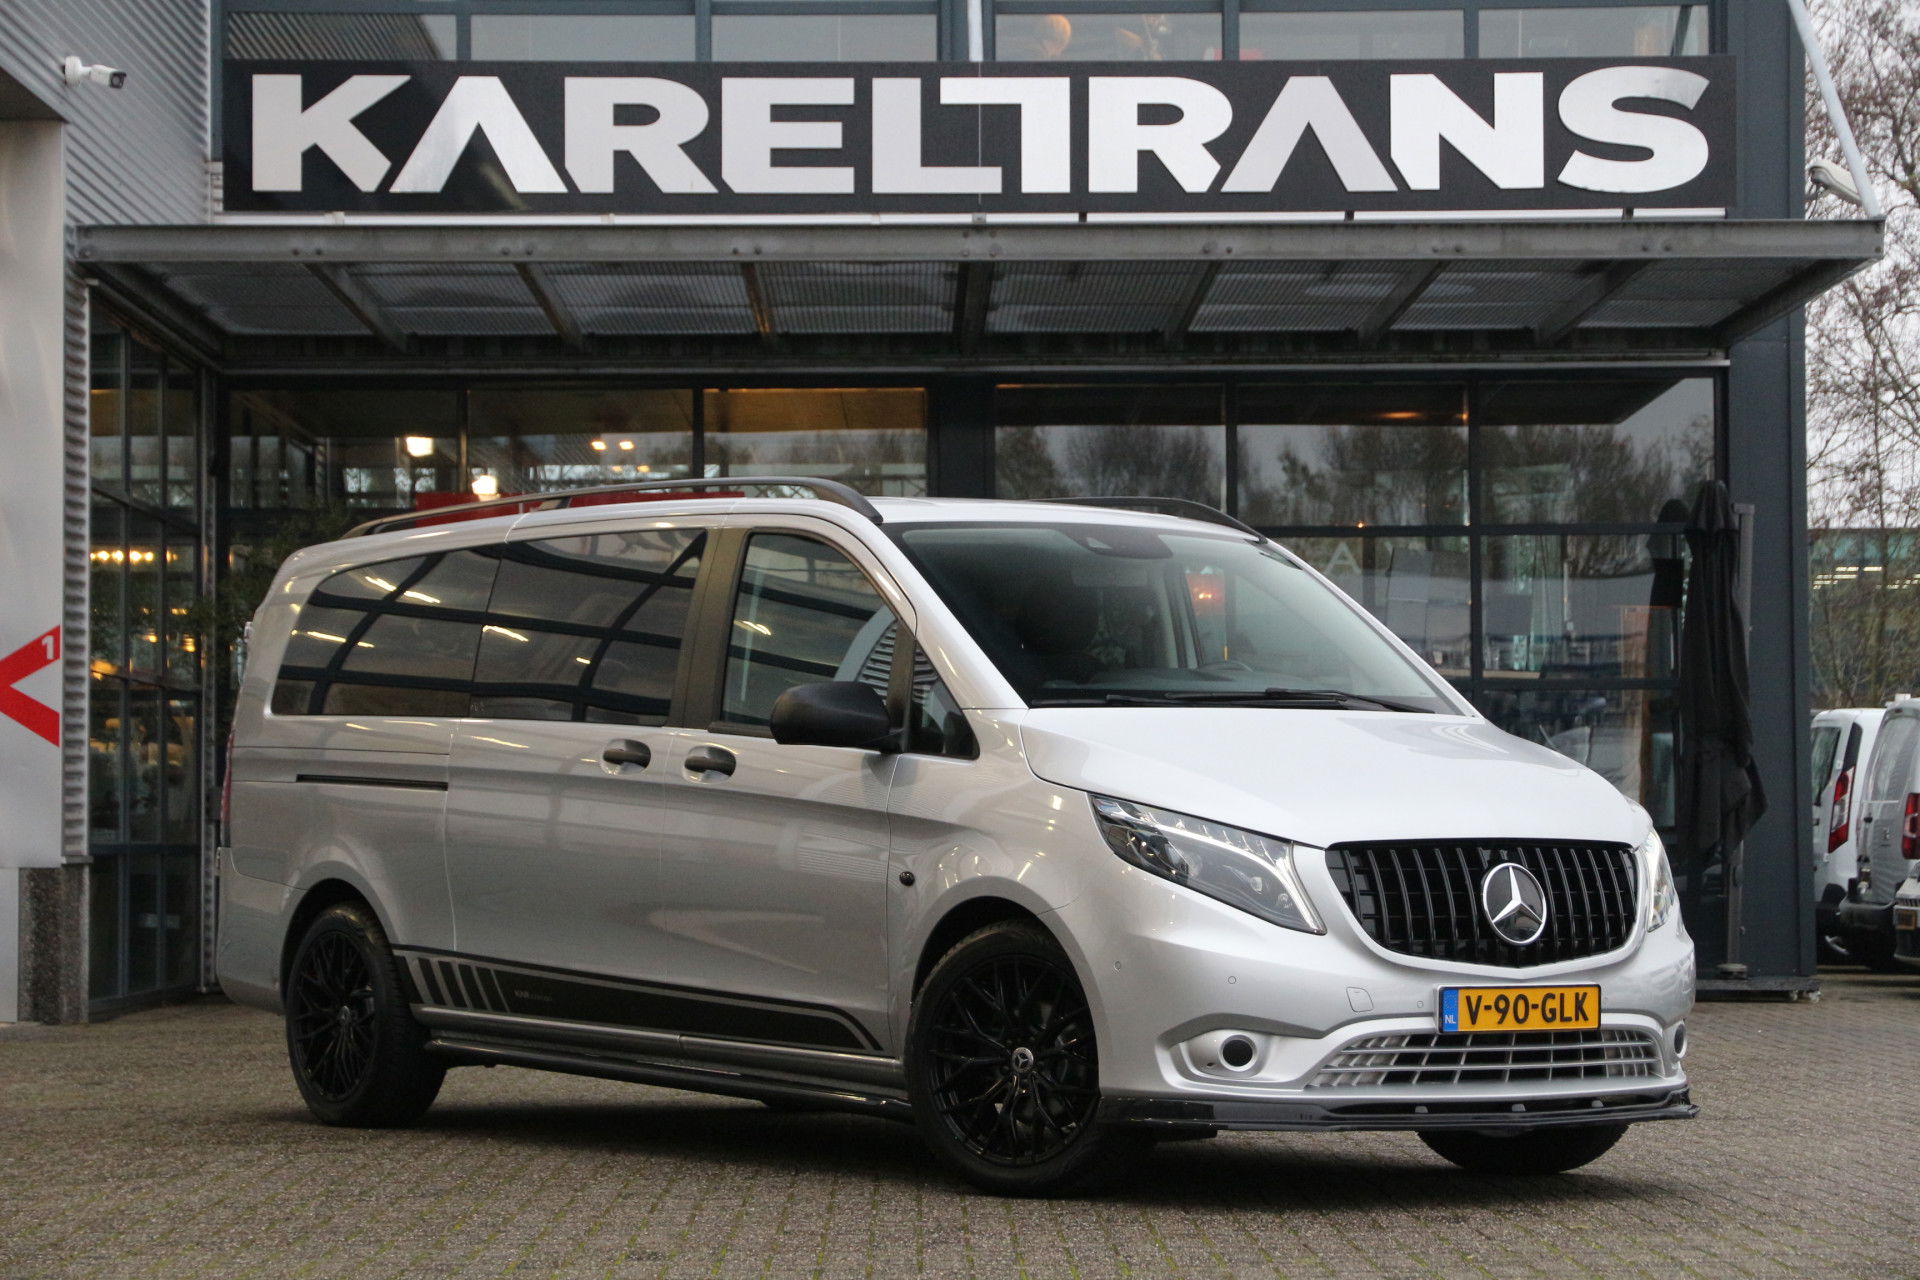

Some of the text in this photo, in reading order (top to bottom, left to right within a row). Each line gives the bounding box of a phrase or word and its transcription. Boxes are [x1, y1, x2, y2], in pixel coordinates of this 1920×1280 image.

[252, 65, 1710, 195] KARELTRANS
[41, 634, 55, 661] 1
[1444, 1013, 1457, 1025] NL
[1465, 991, 1589, 1026] V-90-GLK
